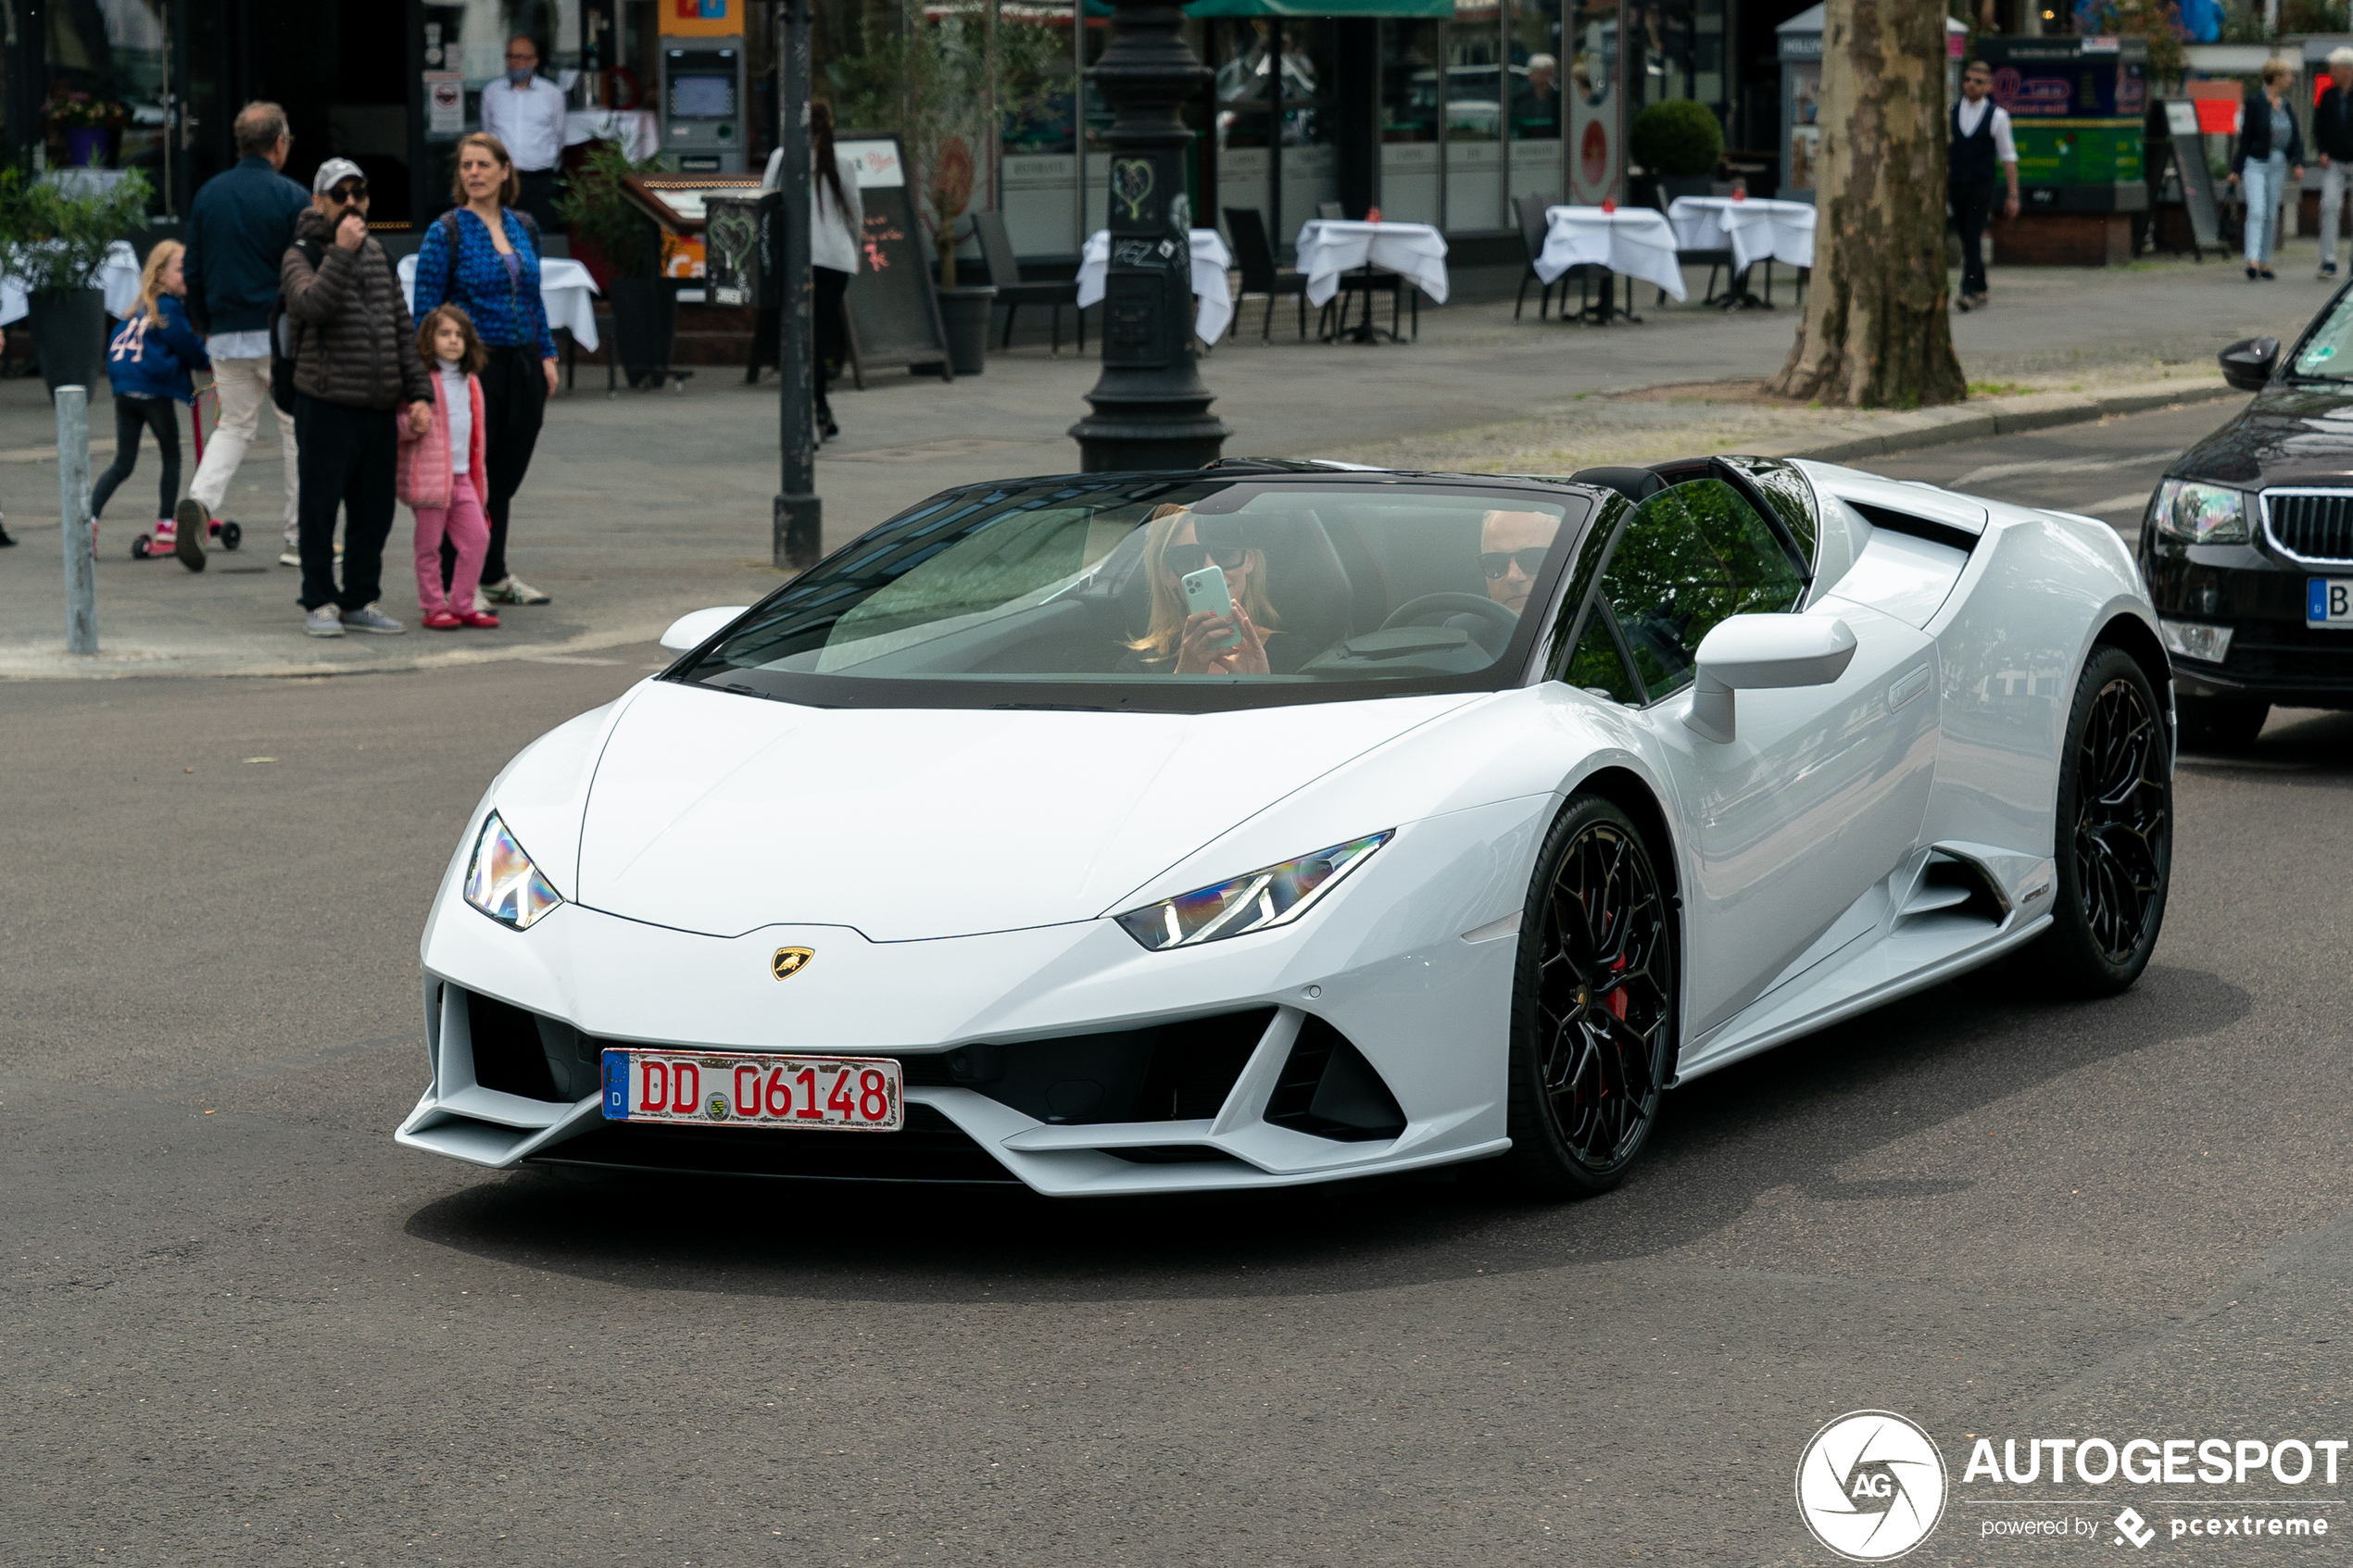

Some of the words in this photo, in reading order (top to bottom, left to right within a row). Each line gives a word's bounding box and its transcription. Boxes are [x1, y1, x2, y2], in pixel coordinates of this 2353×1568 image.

[110, 316, 153, 362] 44
[2330, 586, 2348, 616] B
[612, 1092, 622, 1107] D
[639, 1060, 699, 1114] DD
[734, 1065, 888, 1122] 06148
